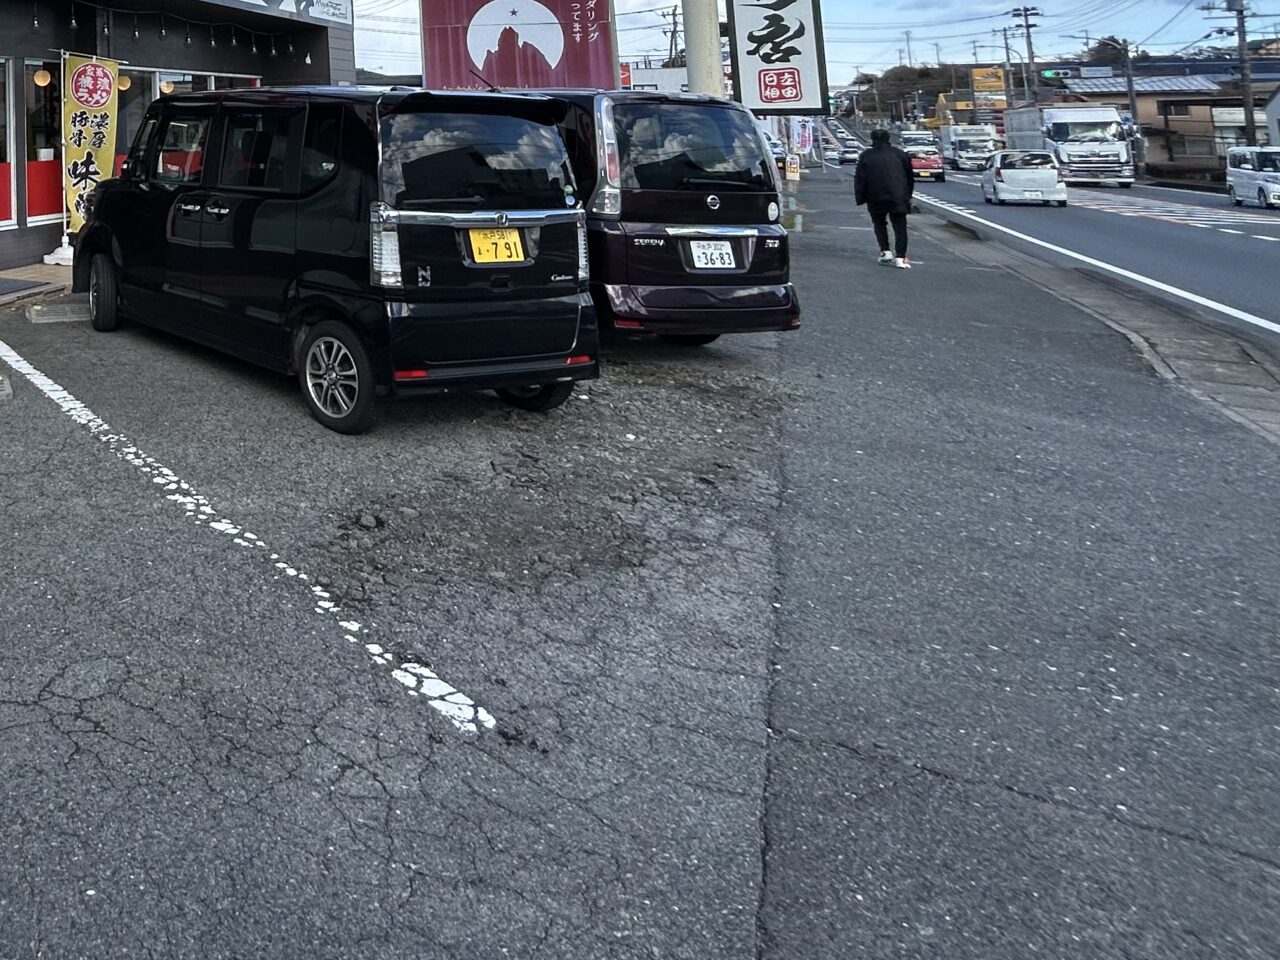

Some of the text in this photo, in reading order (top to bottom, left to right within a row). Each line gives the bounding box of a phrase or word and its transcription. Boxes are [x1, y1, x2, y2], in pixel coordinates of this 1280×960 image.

[78, 87, 110, 106] ラーメン
[70, 110, 90, 148] 豚骨
[89, 111, 110, 148] 濃厚
